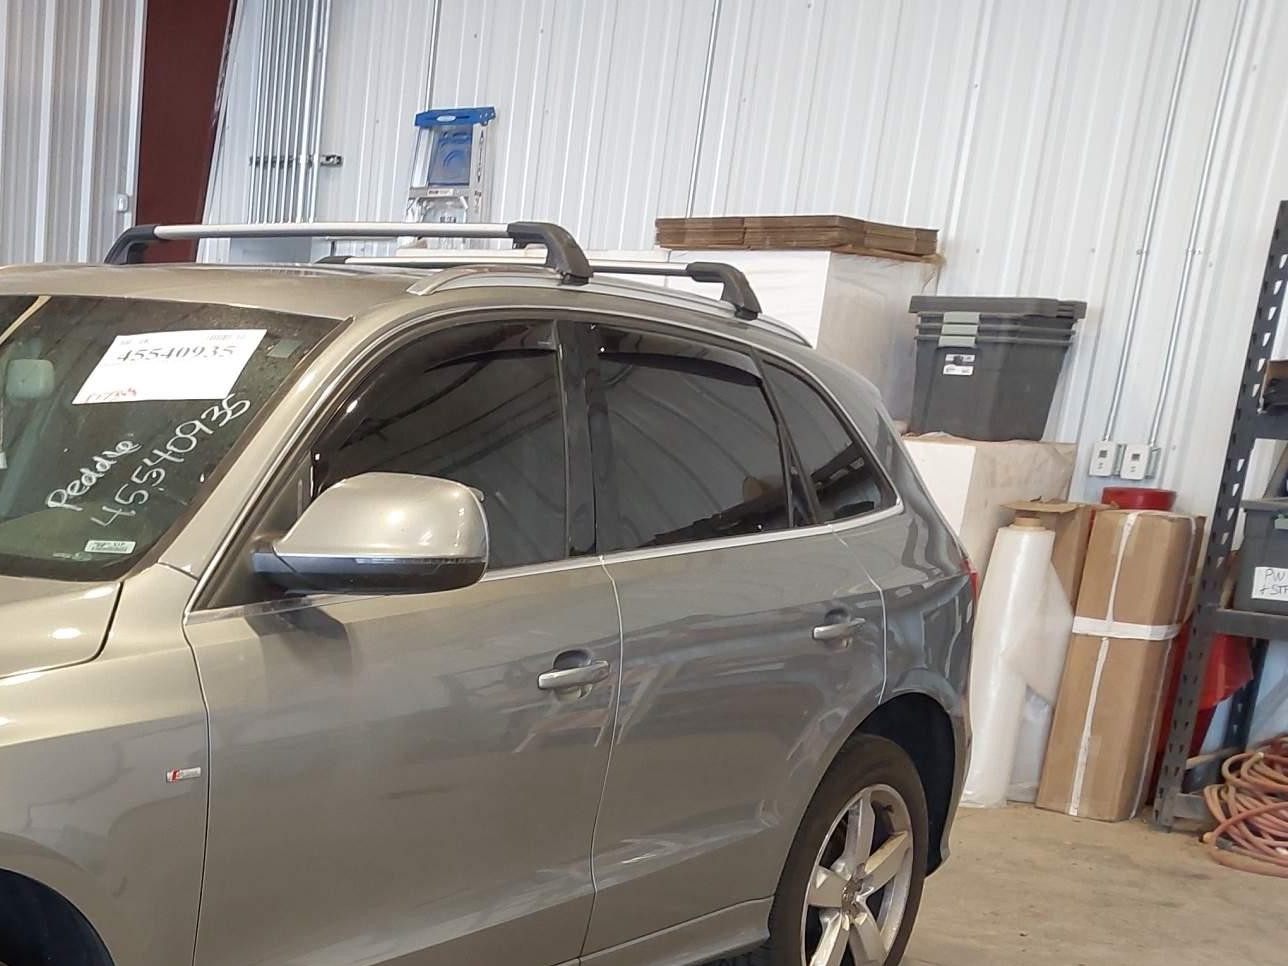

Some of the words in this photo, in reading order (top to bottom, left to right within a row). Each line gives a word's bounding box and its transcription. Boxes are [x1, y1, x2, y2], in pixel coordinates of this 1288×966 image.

[117, 346, 236, 362] 45540935
[45, 440, 142, 511] Peddle
[90, 393, 251, 527] 45540935
